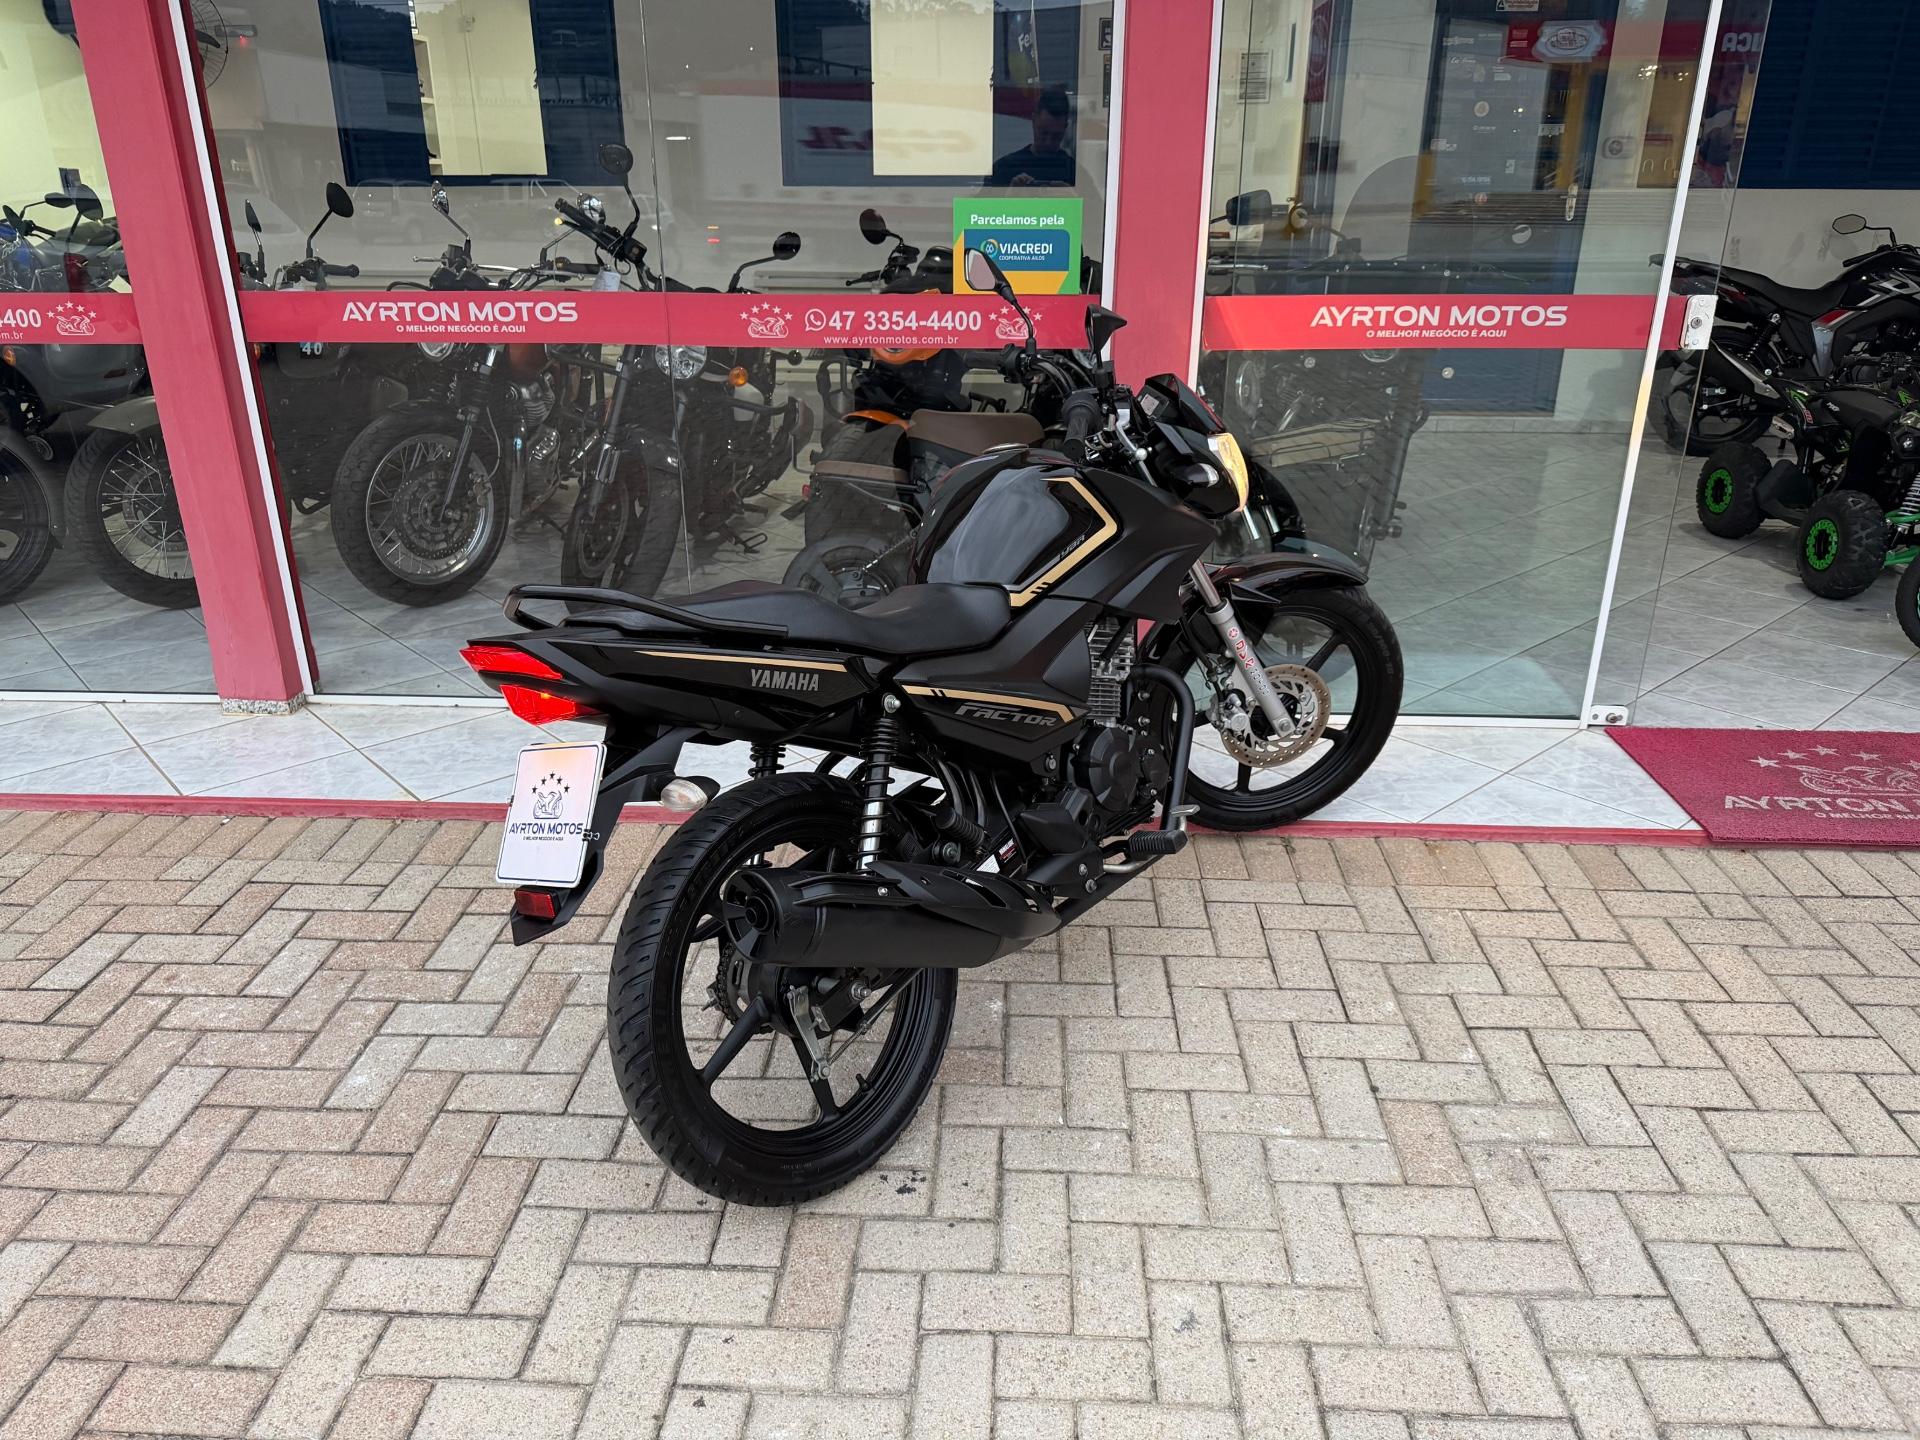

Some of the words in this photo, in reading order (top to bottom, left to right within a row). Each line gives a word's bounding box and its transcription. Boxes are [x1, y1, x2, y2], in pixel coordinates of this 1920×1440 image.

[970, 213, 1037, 226] Parcelamos
[1039, 213, 1065, 228] pela
[999, 243, 1053, 255] VIACREDI
[342, 301, 460, 322] AYRTON
[469, 301, 579, 322] MOTOS
[1310, 305, 1440, 327] AYRTON
[1449, 305, 1569, 327] MOTOS
[396, 325, 404, 333] O
[406, 325, 445, 333] MELHOR
[447, 323, 491, 333] NEGÓCIO
[493, 323, 499, 333] É
[501, 325, 526, 334] AQUI
[828, 310, 856, 331] 47
[863, 310, 982, 331] 3354-4400
[823, 335, 959, 346] www.ayrtonmotos.com.br
[1366, 330, 1375, 338] O
[1376, 330, 1420, 338] MELHOR
[1421, 328, 1469, 338] NEGÓCIO
[1471, 328, 1478, 337] É
[1480, 330, 1507, 338] AQUI
[750, 668, 820, 692] YAMAHA
[953, 702, 1058, 727] FACTOR
[1724, 795, 1911, 813] AYRTON
[509, 823, 546, 835] AYRTON
[547, 823, 583, 835] MOTOS
